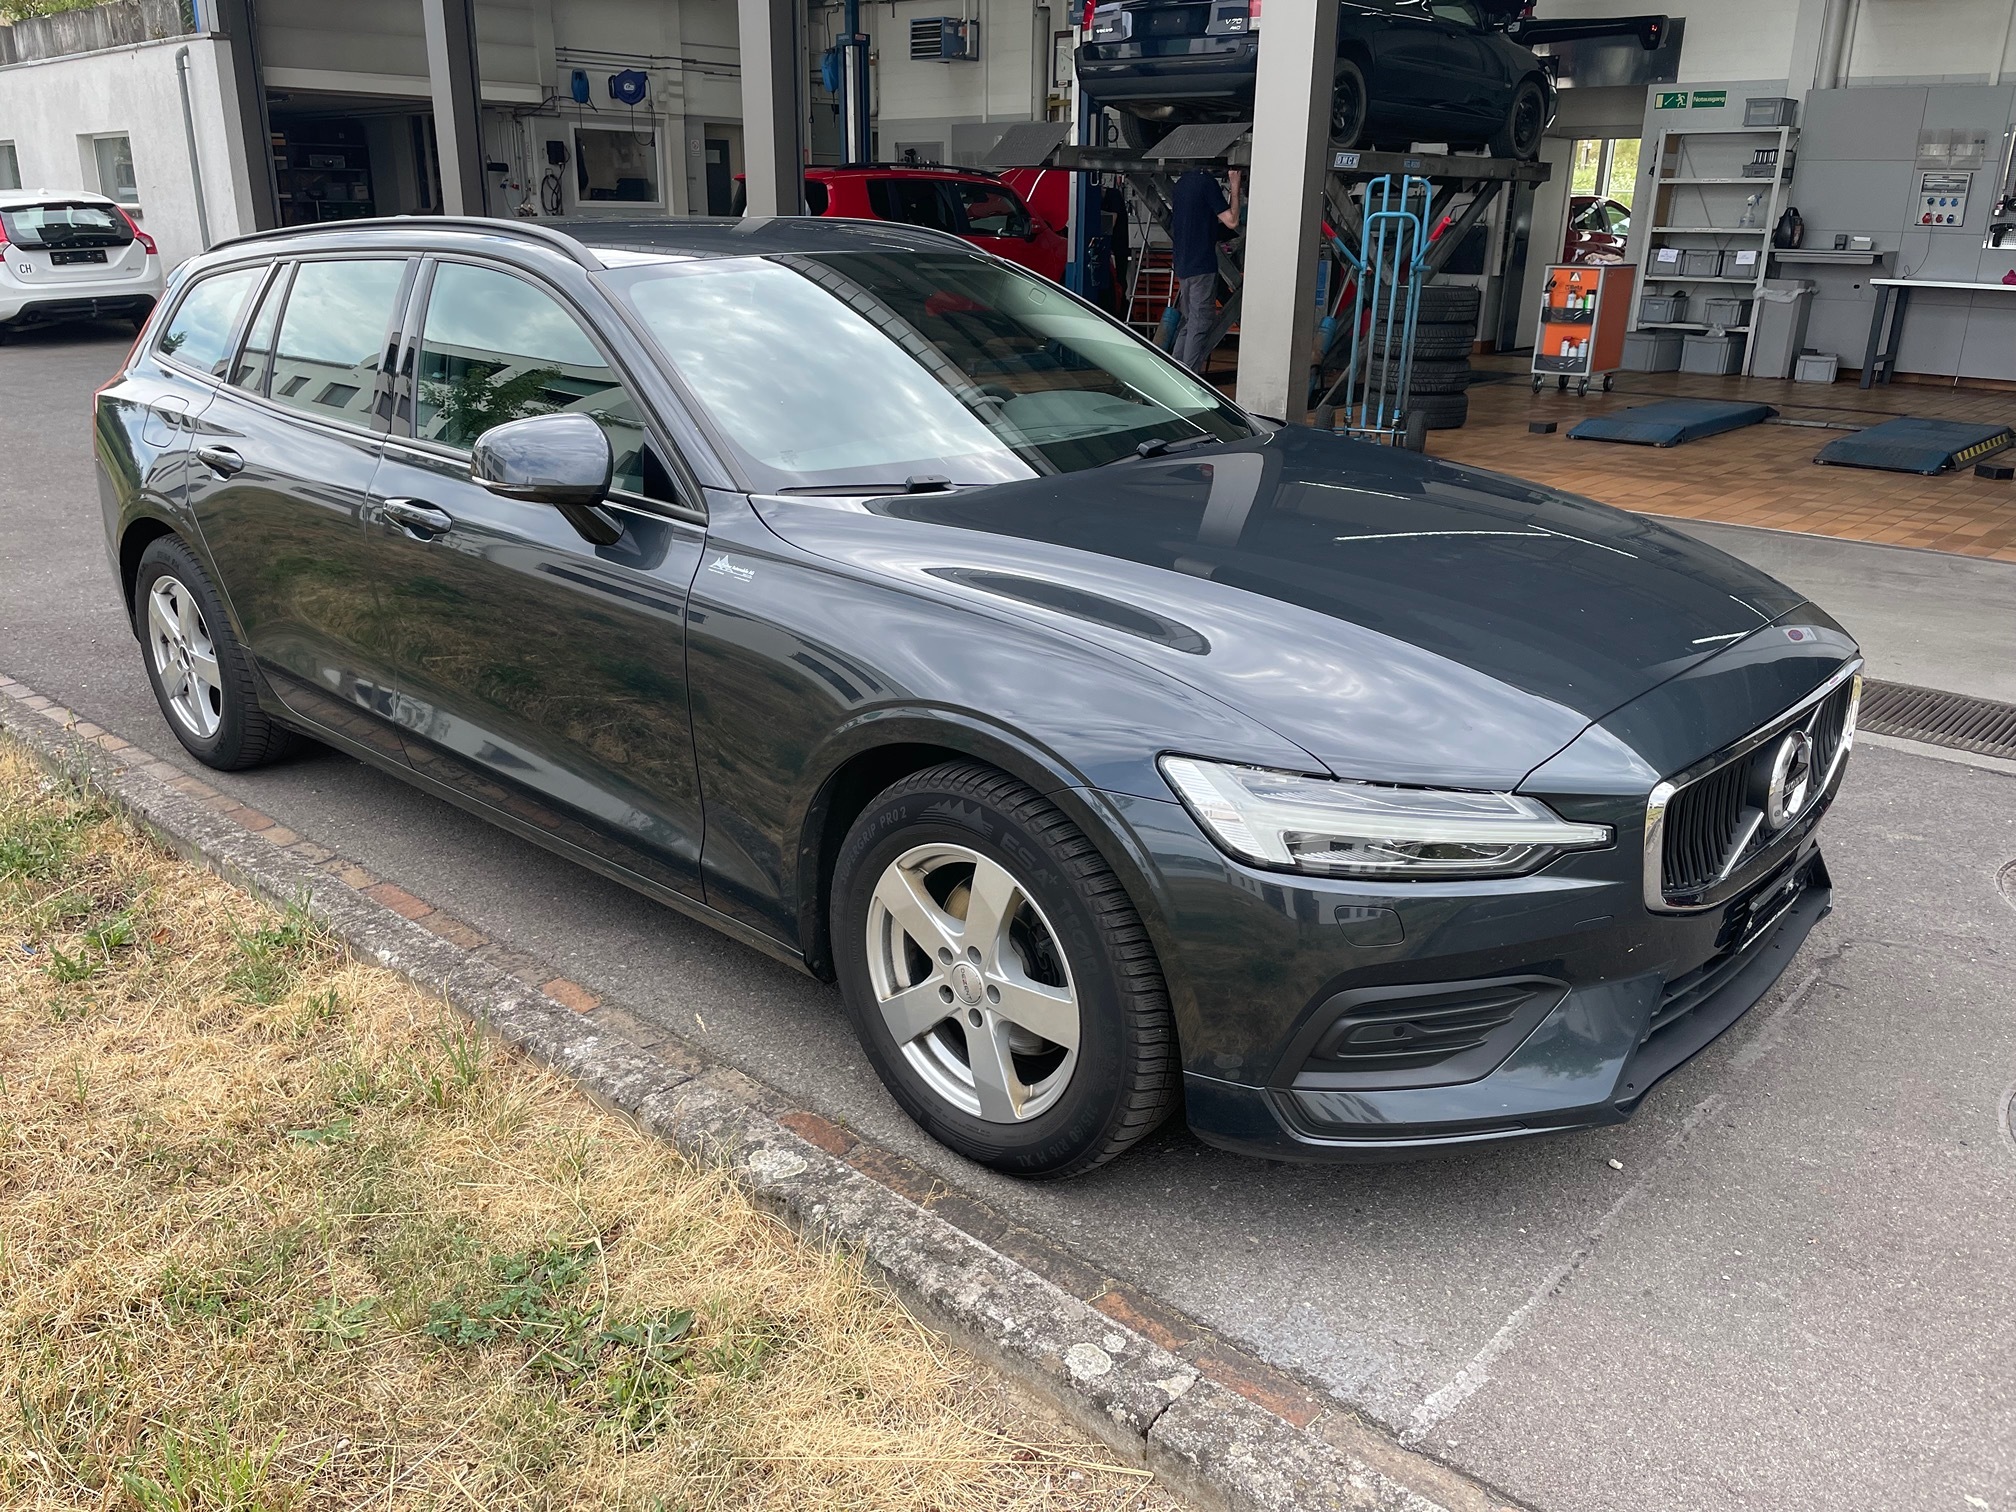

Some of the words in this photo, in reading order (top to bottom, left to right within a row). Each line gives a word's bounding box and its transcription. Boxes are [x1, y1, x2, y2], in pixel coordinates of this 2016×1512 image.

[19, 264, 32, 274] CH
[841, 823, 876, 885] SUPERGRIP
[900, 806, 907, 819] 2
[960, 967, 973, 1000] DEZENT
[1049, 1138, 1071, 1158] R16
[1016, 1153, 1035, 1167] XL
[1036, 1150, 1048, 1164] H
